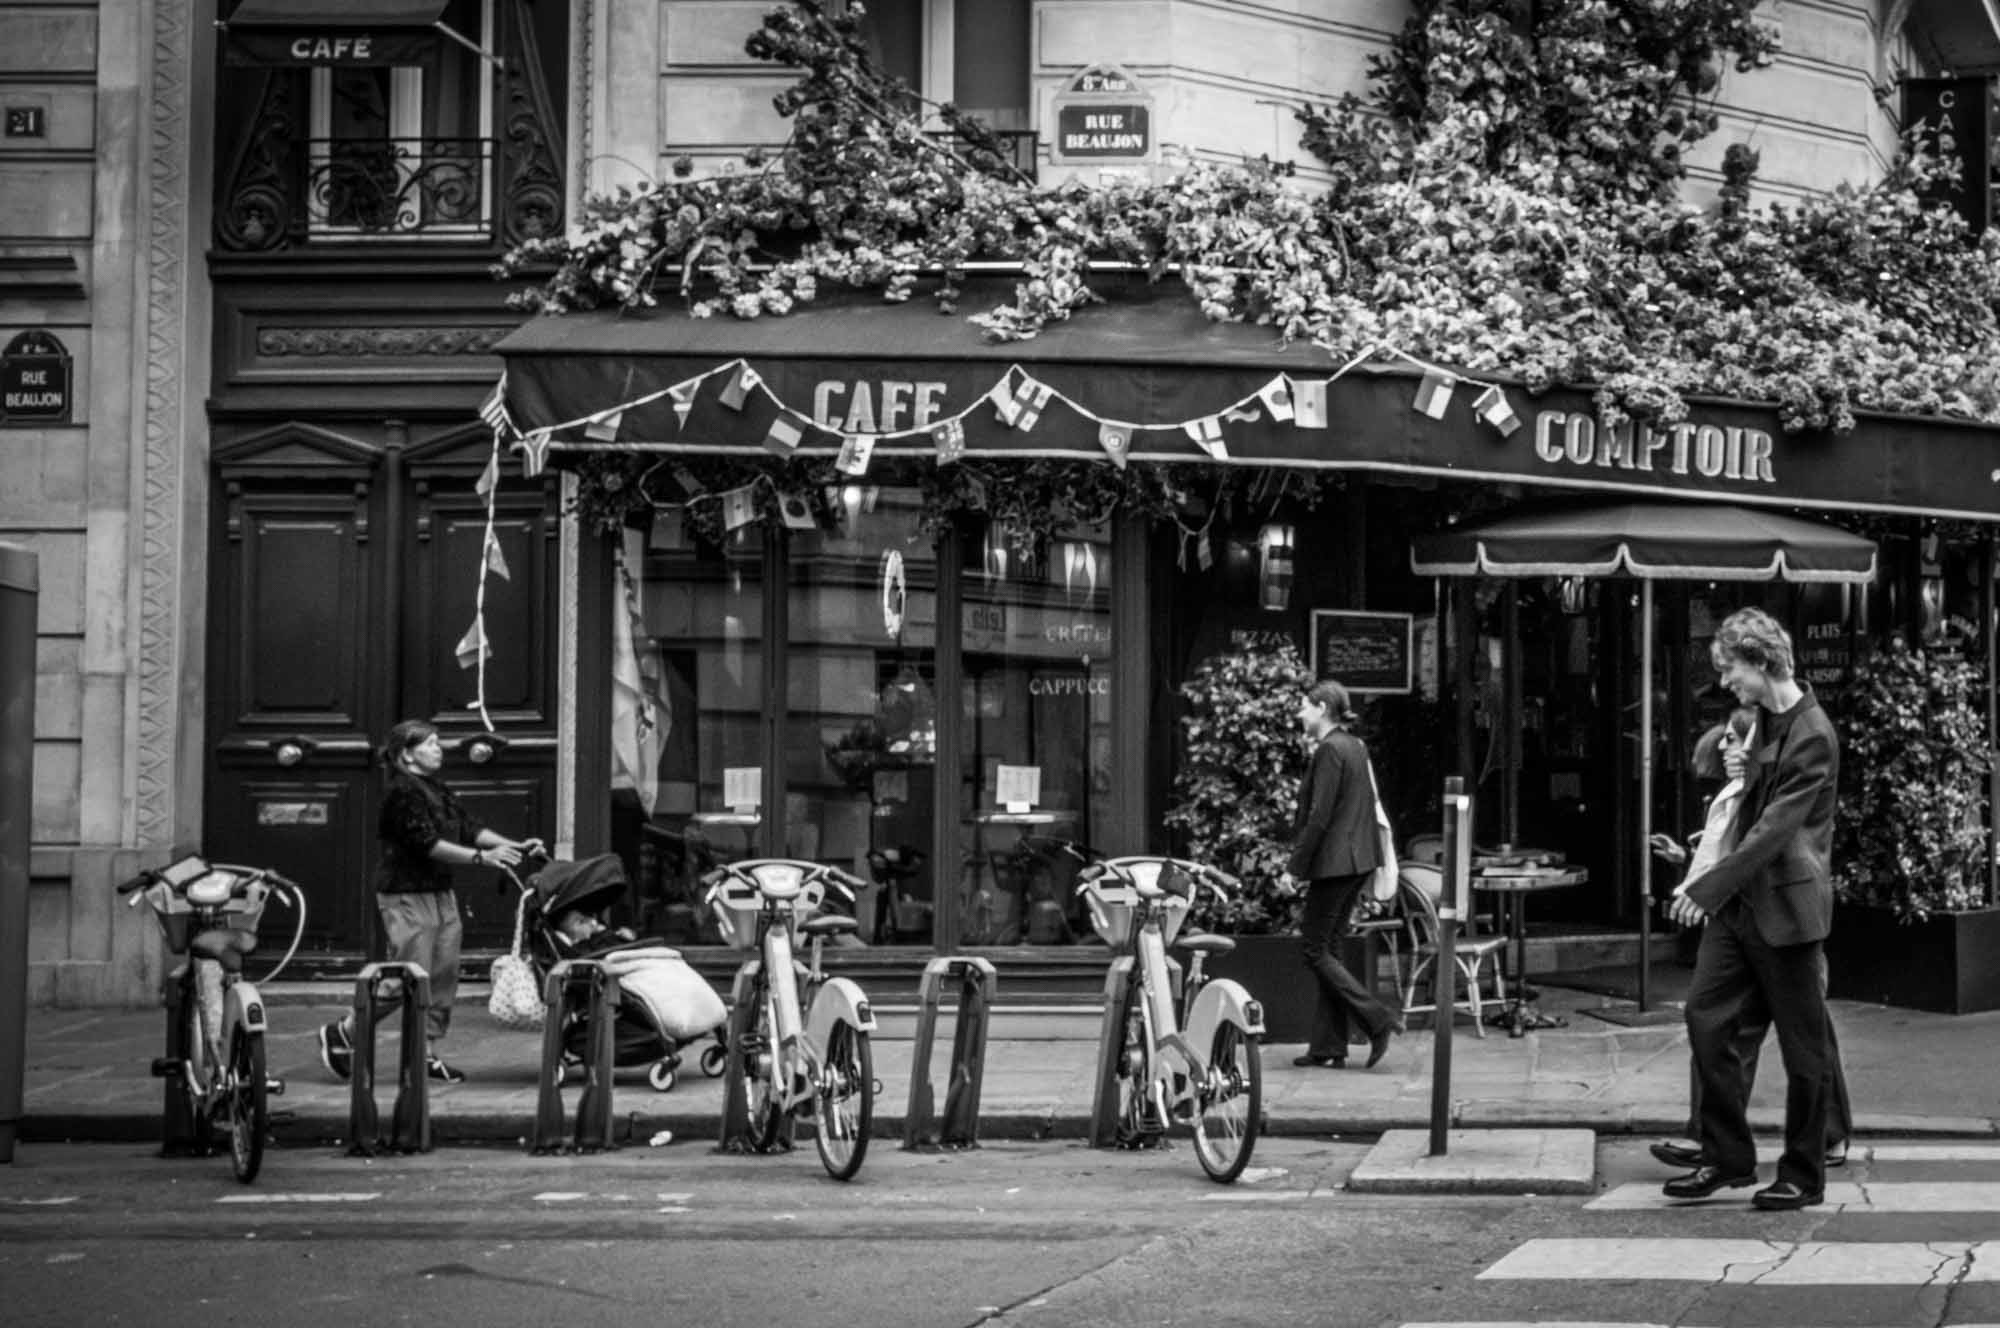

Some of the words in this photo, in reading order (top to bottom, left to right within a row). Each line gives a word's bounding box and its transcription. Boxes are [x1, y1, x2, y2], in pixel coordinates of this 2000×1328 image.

[1085, 114, 1124, 130] RUE
[1065, 134, 1143, 149] BEAUJON
[21, 370, 47, 385] RUE
[5, 391, 63, 407] BEAUJON
[1535, 410, 1777, 483] COMPTOIR
